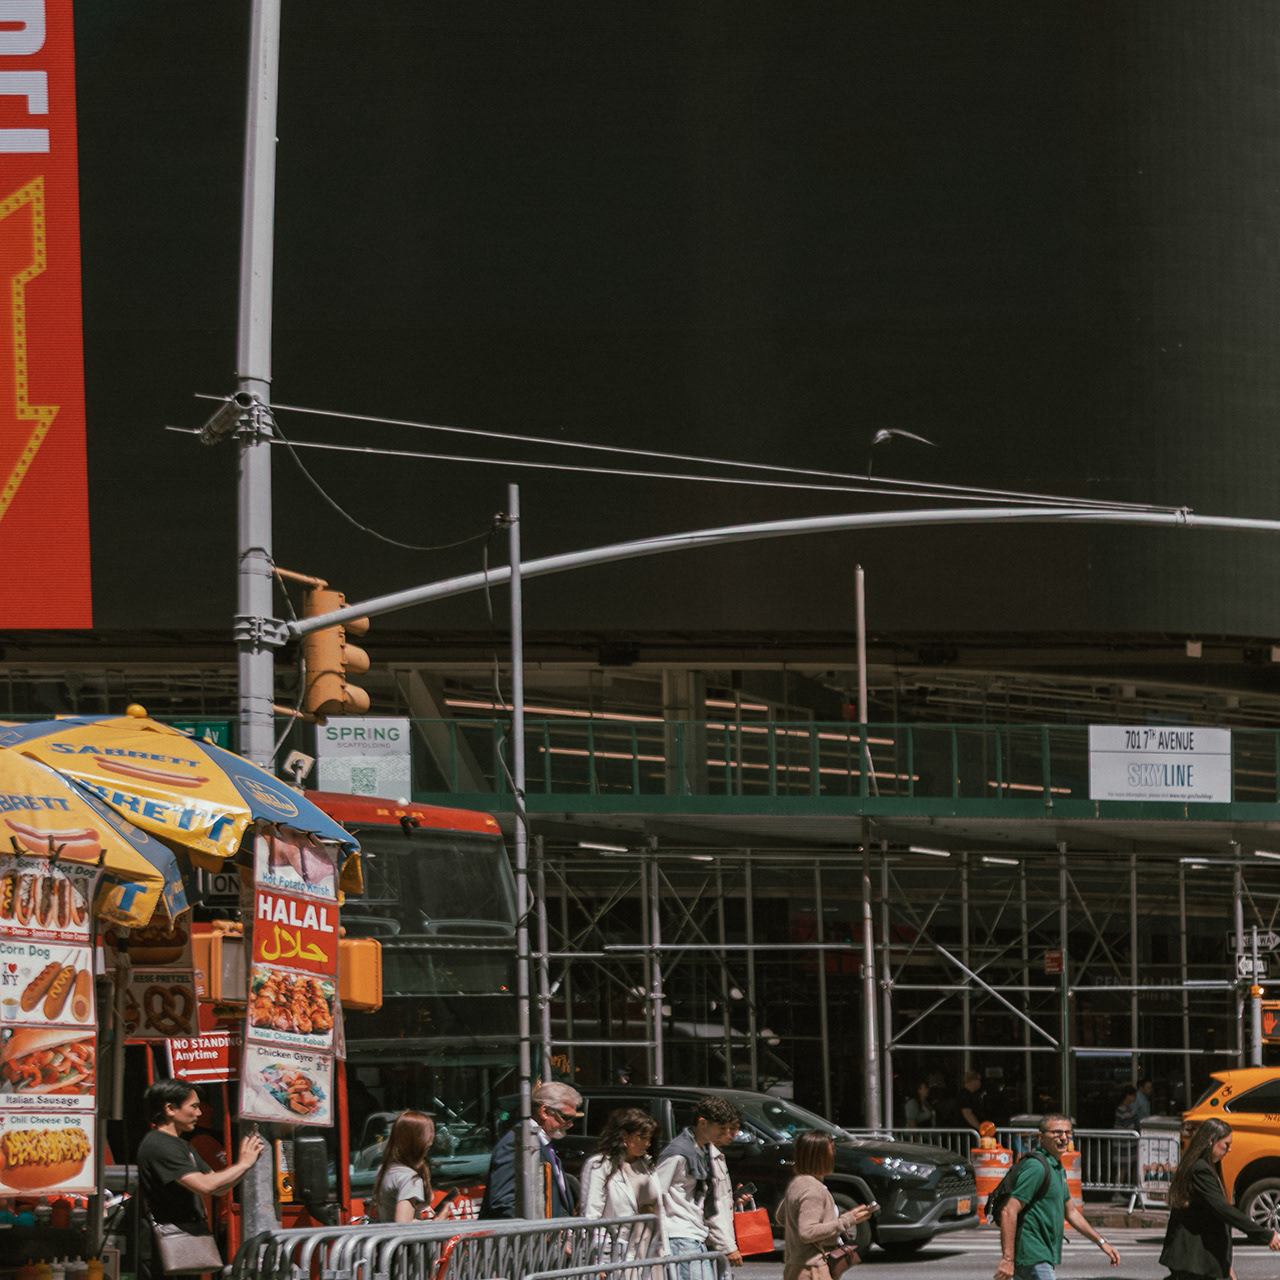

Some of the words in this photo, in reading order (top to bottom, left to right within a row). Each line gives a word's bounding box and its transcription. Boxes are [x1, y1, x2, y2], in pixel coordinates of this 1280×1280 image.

[326, 726, 400, 741] SPRING
[1125, 730, 1141, 749] 701
[1158, 731, 1194, 750] AVENUE
[50, 743, 200, 768] SABRETT
[1127, 763, 1194, 787] SKYLINE
[75, 866, 98, 879] Dog
[262, 872, 276, 884] Hot
[307, 882, 330, 896] Knish
[258, 894, 334, 933] HALAL
[0, 944, 25, 956] Corn
[29, 945, 50, 960] Dog
[261, 925, 328, 963] حلال
[155, 975, 192, 984] PRETZEL
[173, 1038, 188, 1050] NO
[274, 1031, 302, 1043] Chicken
[303, 1036, 326, 1047] Kebab
[175, 1050, 219, 1062] Anytime
[257, 1047, 292, 1060] Chicken
[294, 1051, 314, 1064] Gyro
[6, 1095, 34, 1105] Italian
[37, 1095, 80, 1106] Sausage
[10, 1116, 28, 1124] Chili
[30, 1116, 62, 1125] Cheese
[64, 1117, 81, 1127] Dog
